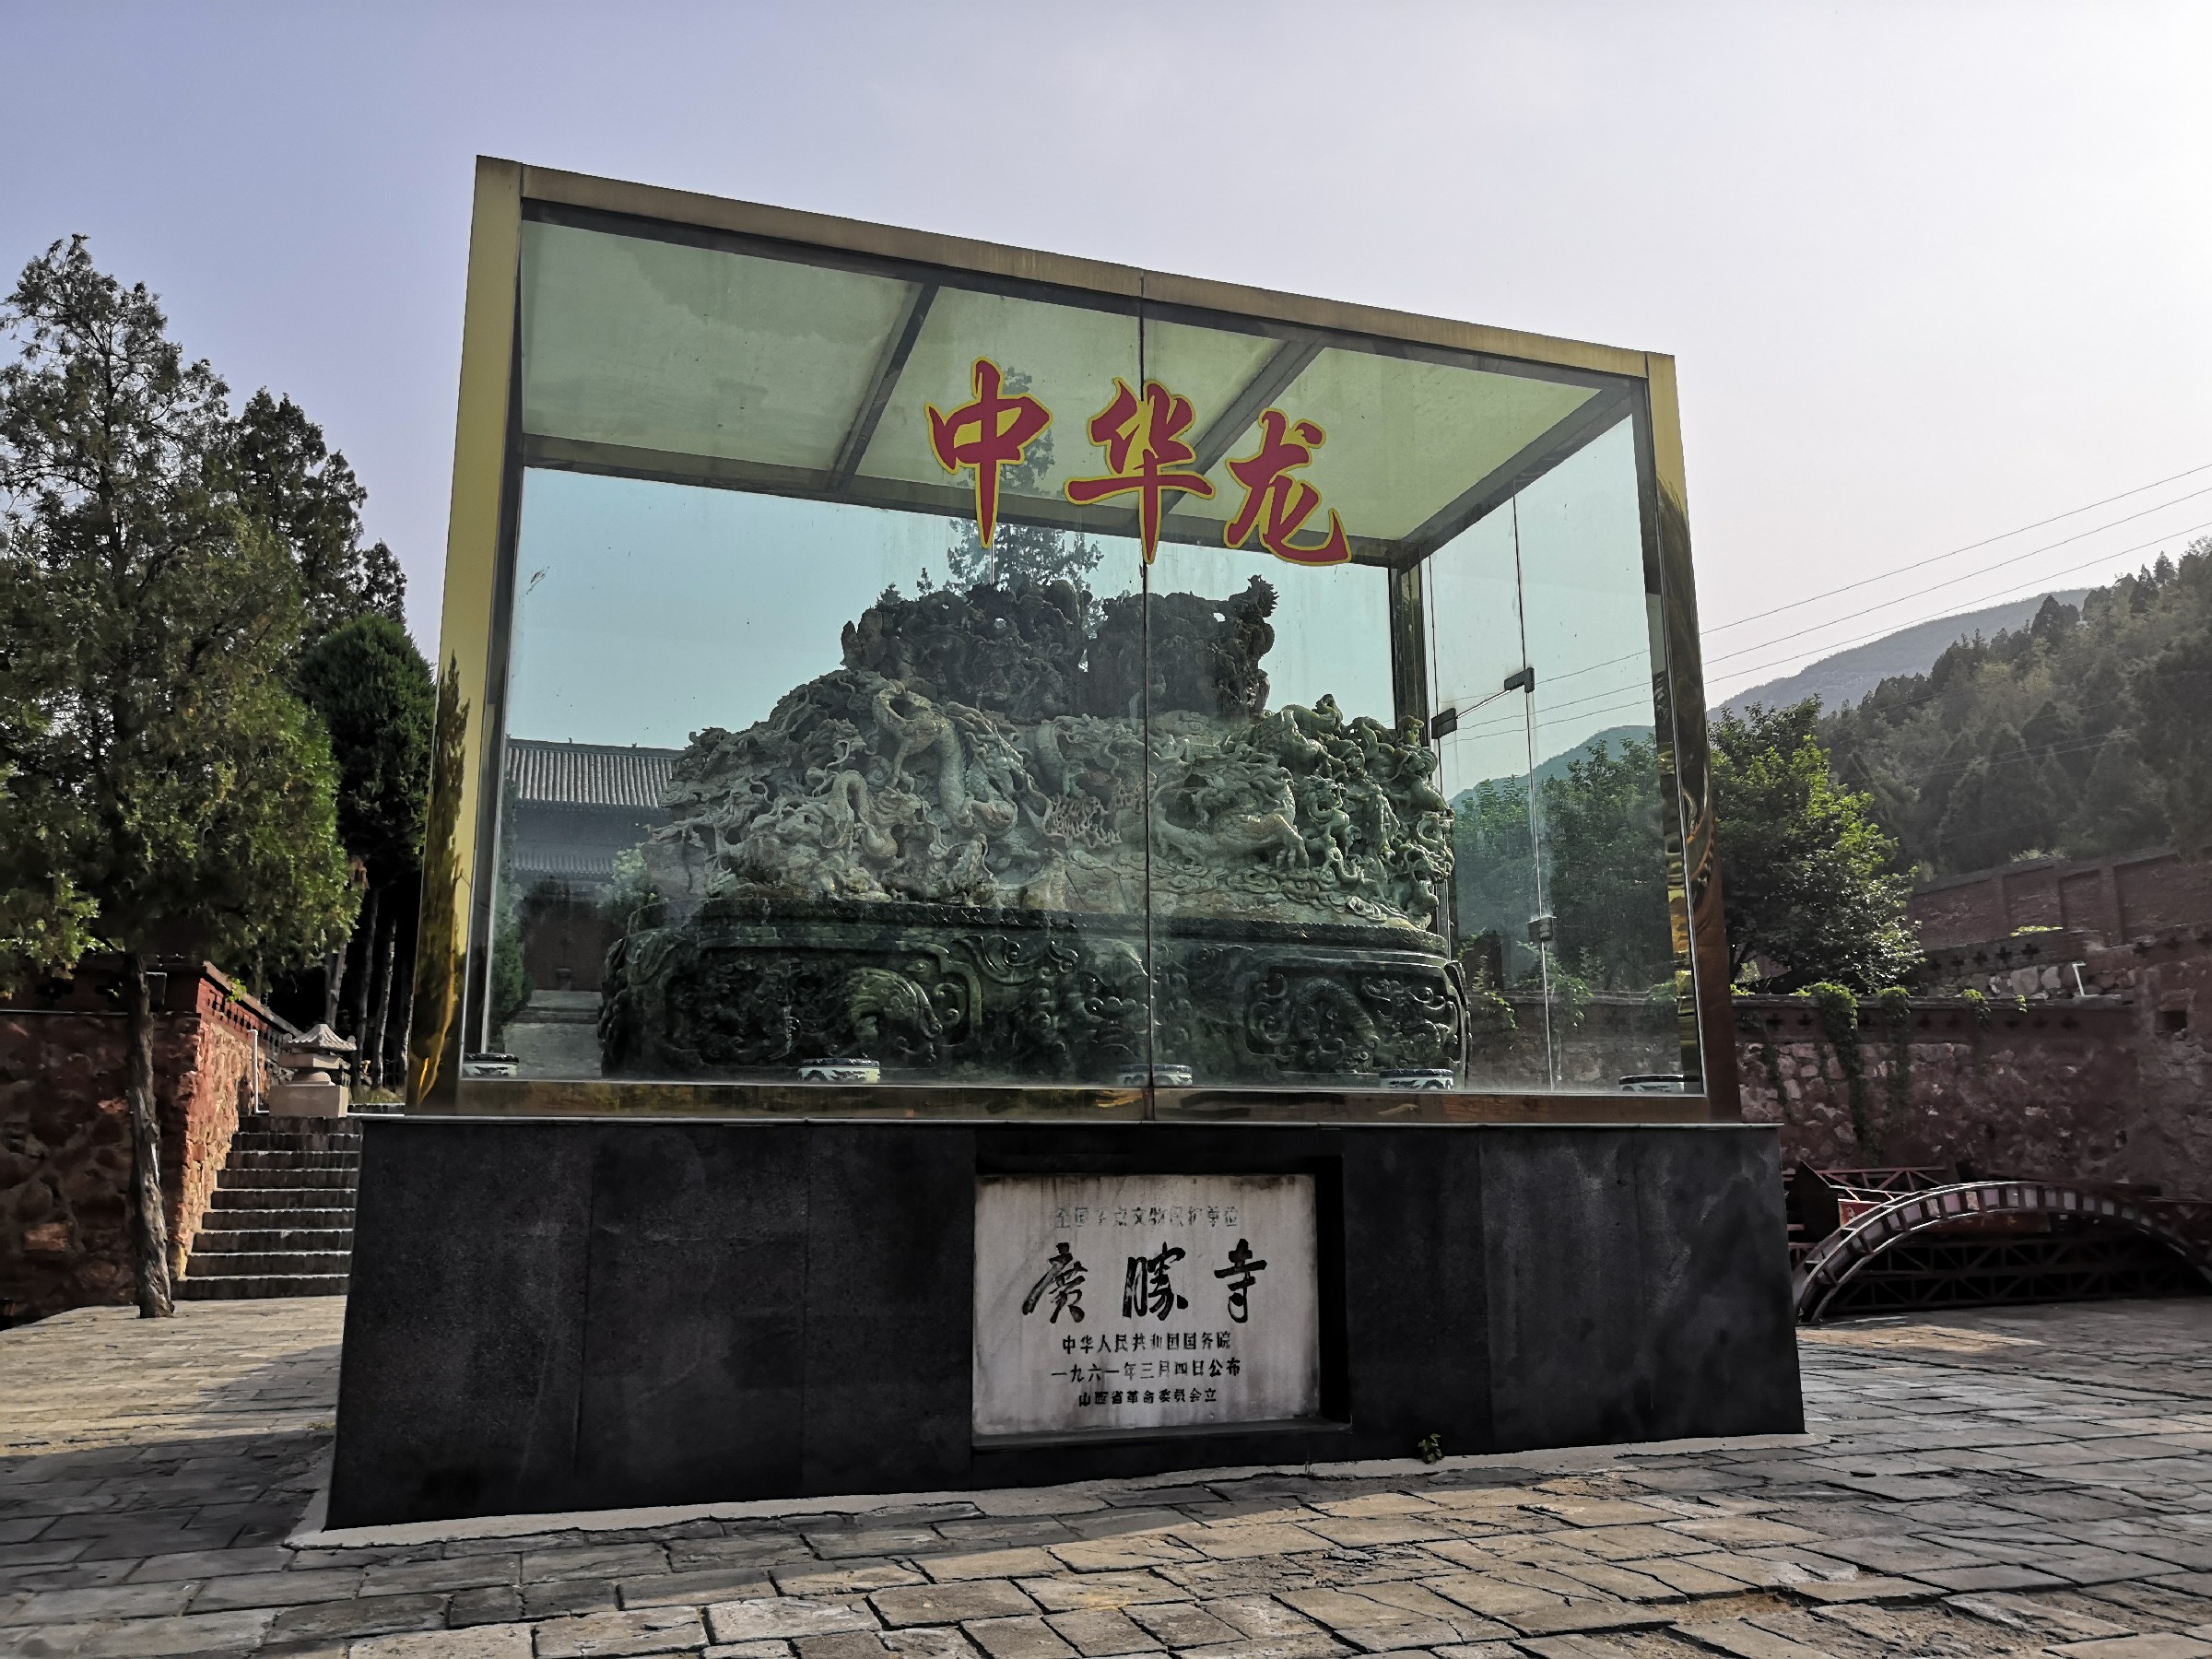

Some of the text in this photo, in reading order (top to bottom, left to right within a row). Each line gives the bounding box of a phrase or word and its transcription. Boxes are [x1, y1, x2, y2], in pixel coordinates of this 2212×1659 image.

[925, 357, 1352, 564] 中华龙
[1022, 1238, 1266, 1324] 廣勝寺
[1051, 1358, 1241, 1382] 一九六一年三月四日公布
[1078, 1388, 1218, 1407] 山西省革命委员会立
